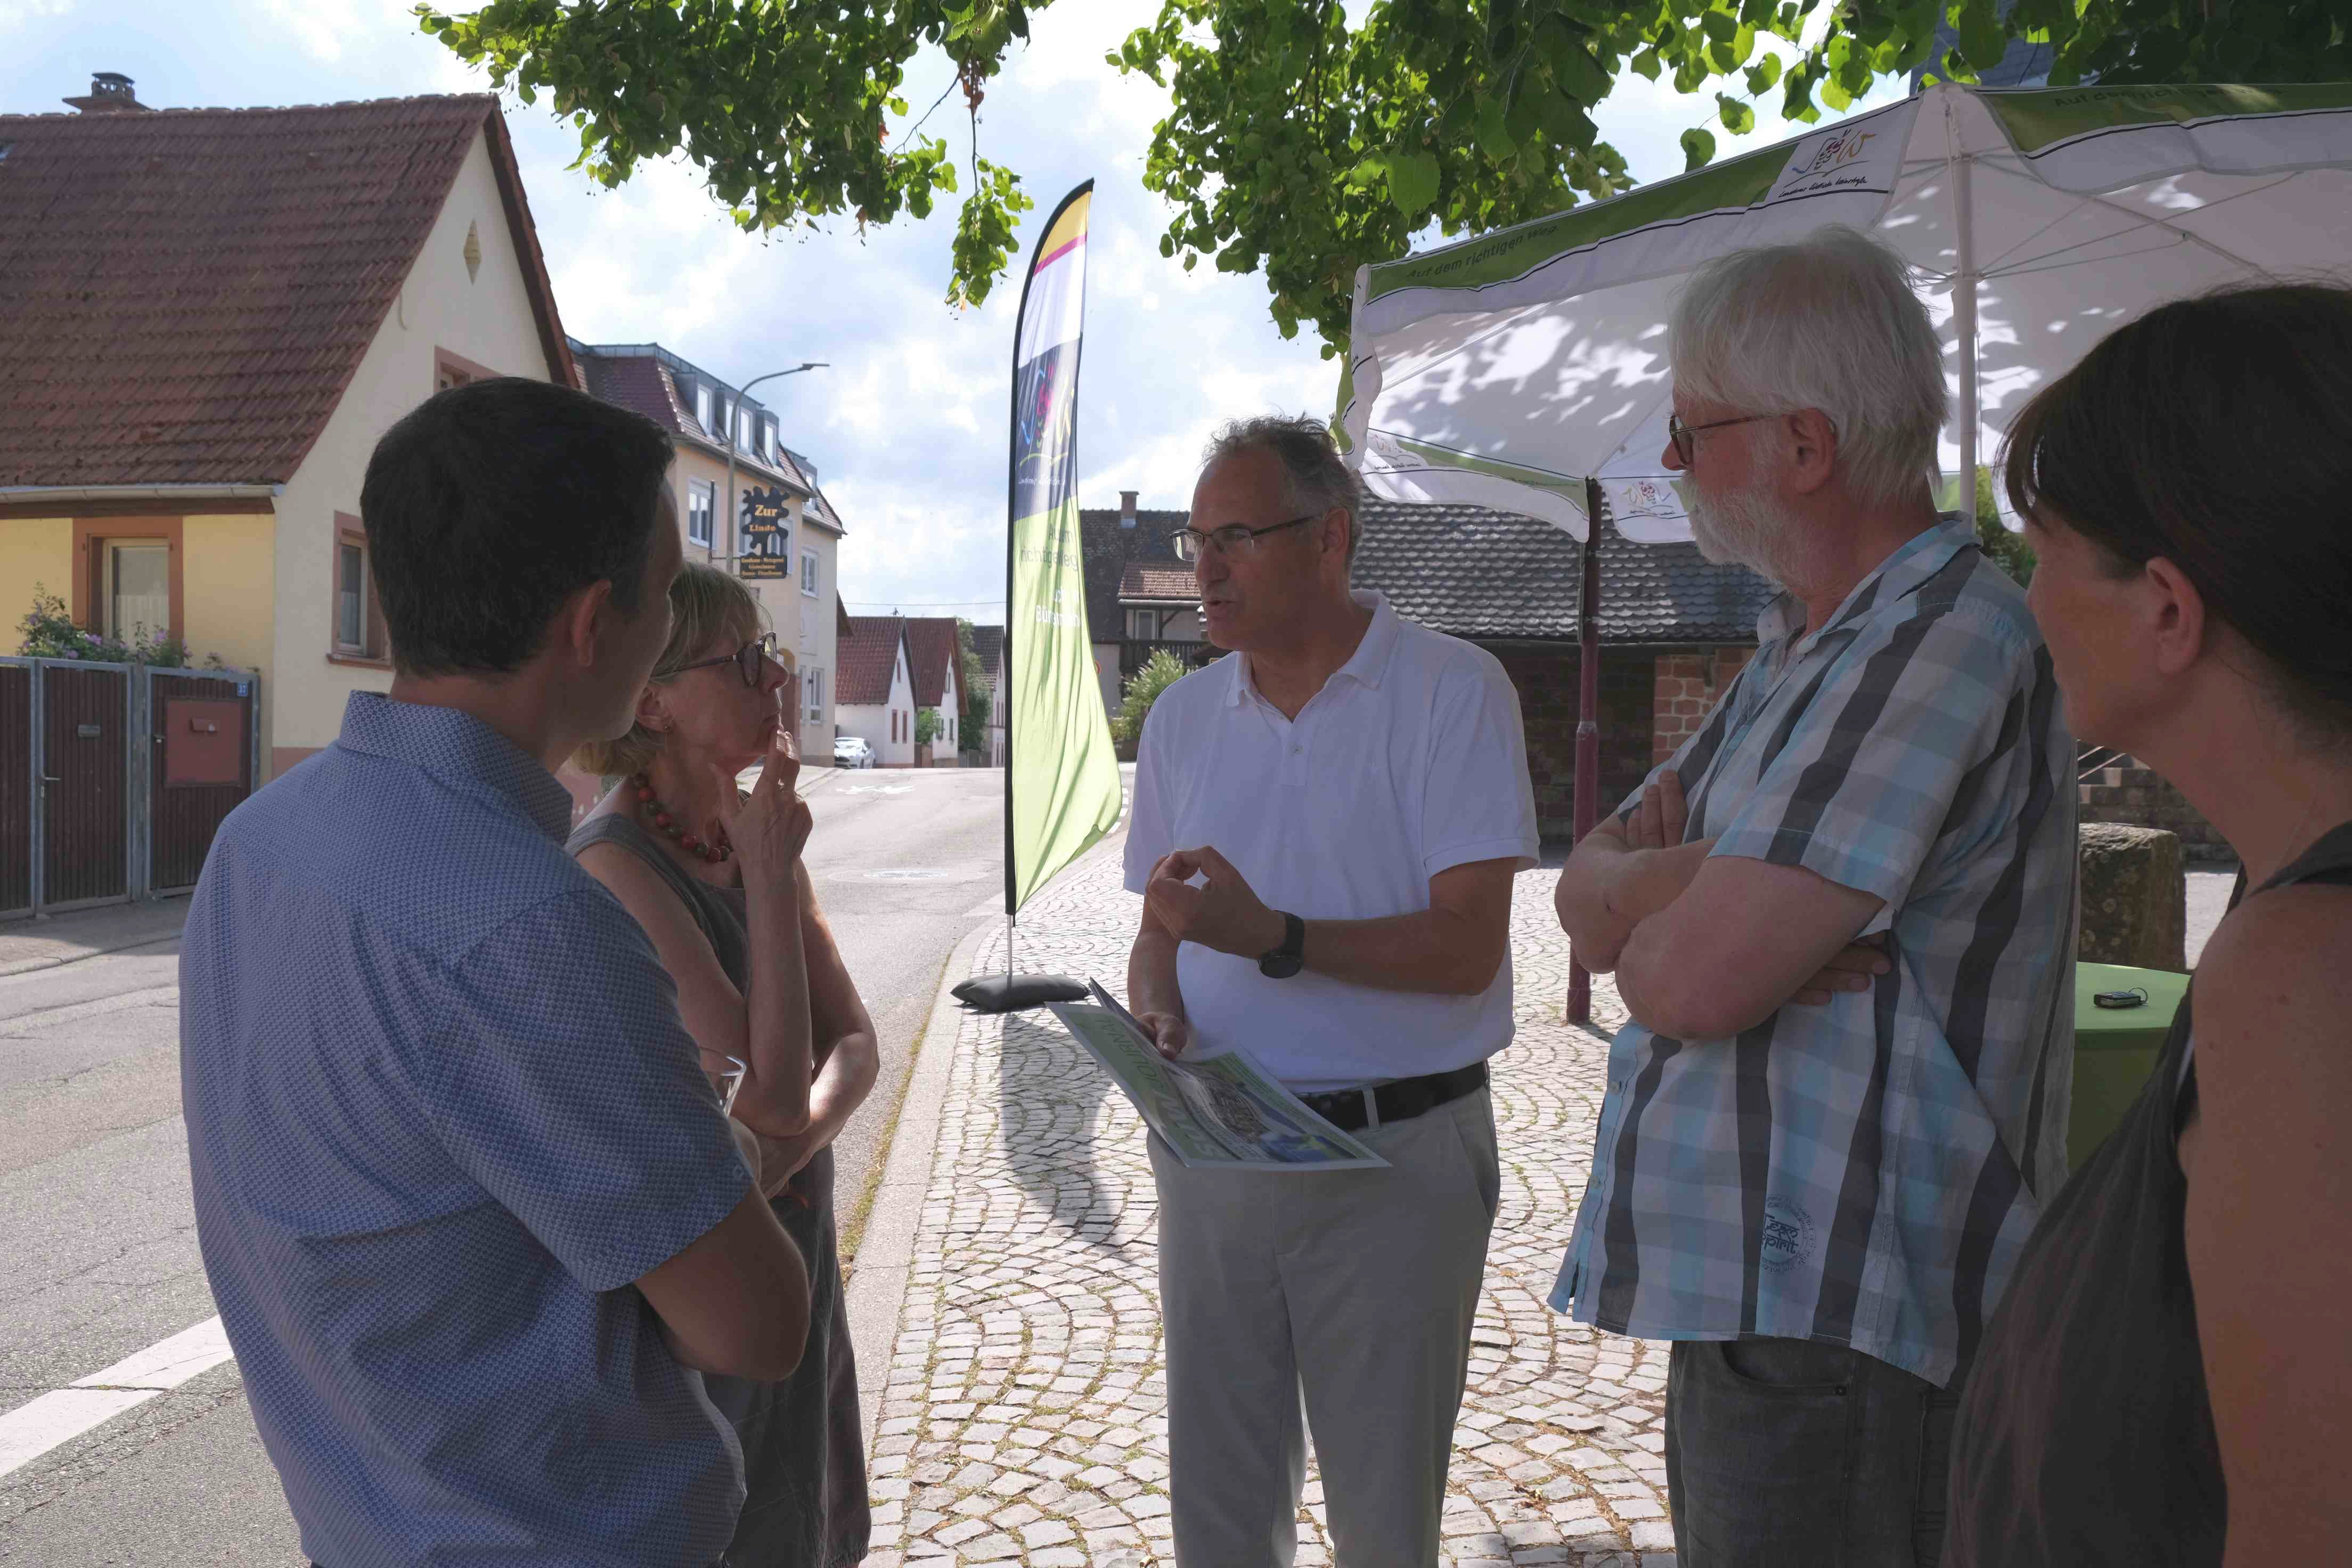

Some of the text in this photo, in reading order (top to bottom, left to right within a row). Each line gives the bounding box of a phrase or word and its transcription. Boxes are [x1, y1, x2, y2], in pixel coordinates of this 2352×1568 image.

[2054, 93, 2087, 106] Auf
[1407, 266, 1434, 278] Auf
[1435, 259, 1462, 276] dem
[1465, 235, 1524, 266] richtigen
[754, 504, 778, 516] Zur
